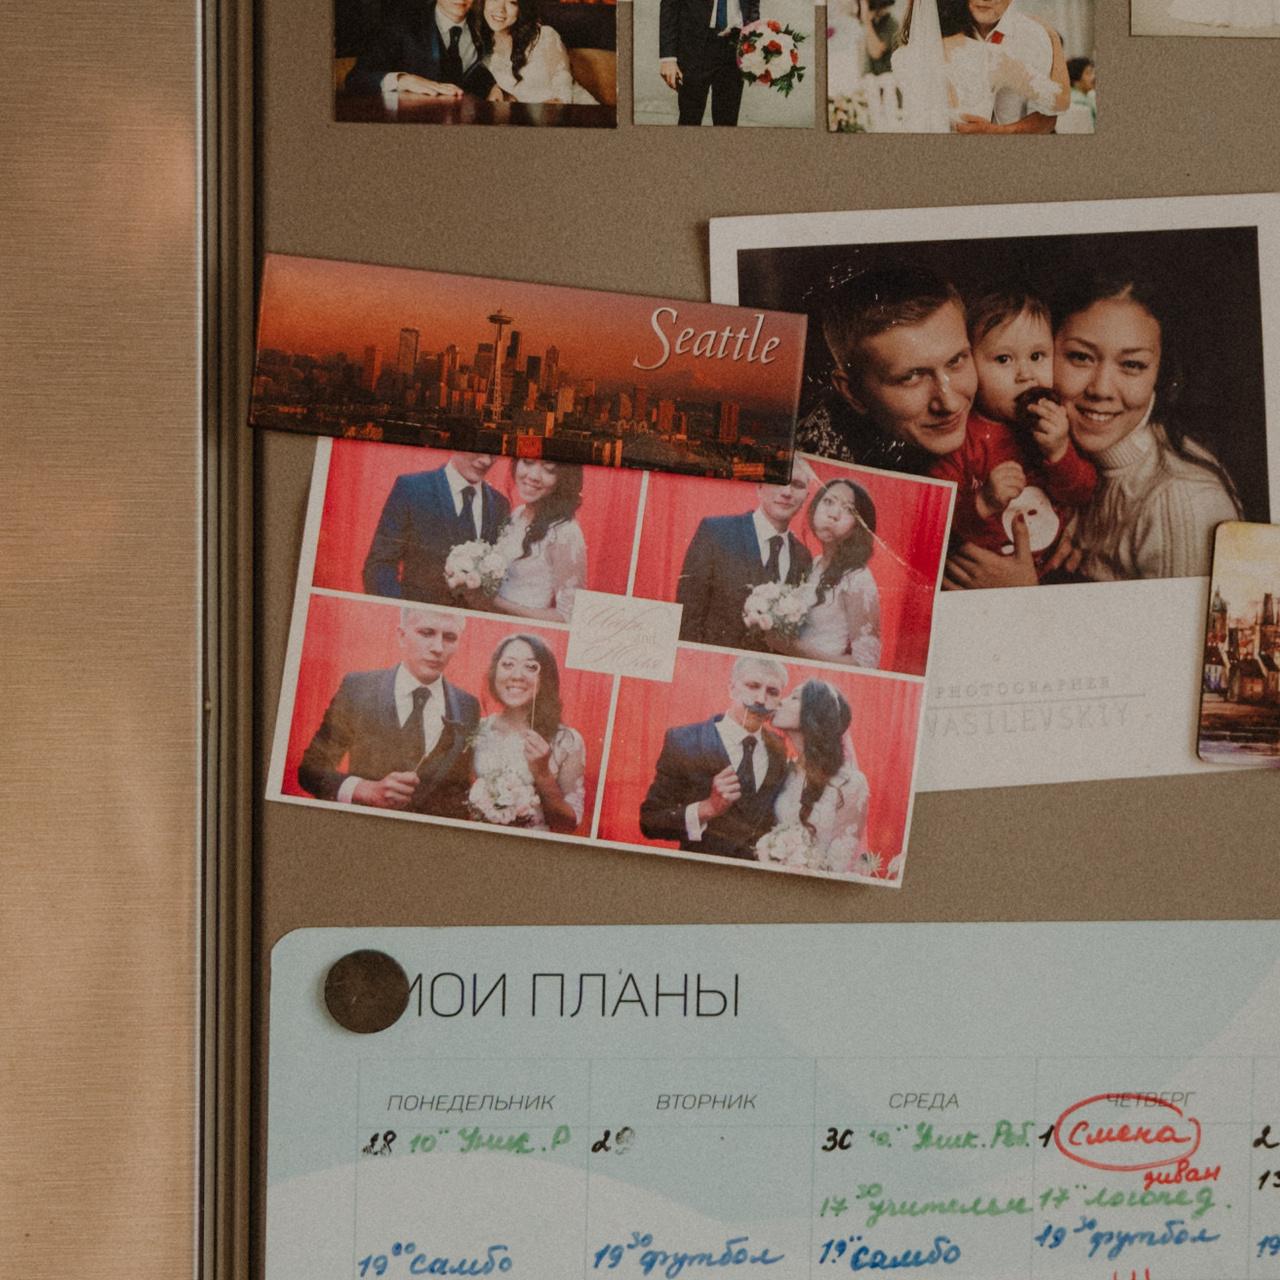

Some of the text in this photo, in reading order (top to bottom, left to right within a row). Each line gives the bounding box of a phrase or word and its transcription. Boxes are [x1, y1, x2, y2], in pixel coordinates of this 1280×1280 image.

[632, 306, 782, 371] Seattle
[532, 972, 740, 1018] ПЛАНЫ
[386, 1092, 556, 1114] ПОНЕДЕЛЬНИК
[656, 1092, 758, 1111] ВТОРНИК
[888, 1092, 961, 1111] СРЕДА
[1068, 1121, 1191, 1147] Смена
[1253, 1126, 1280, 1149] 2
